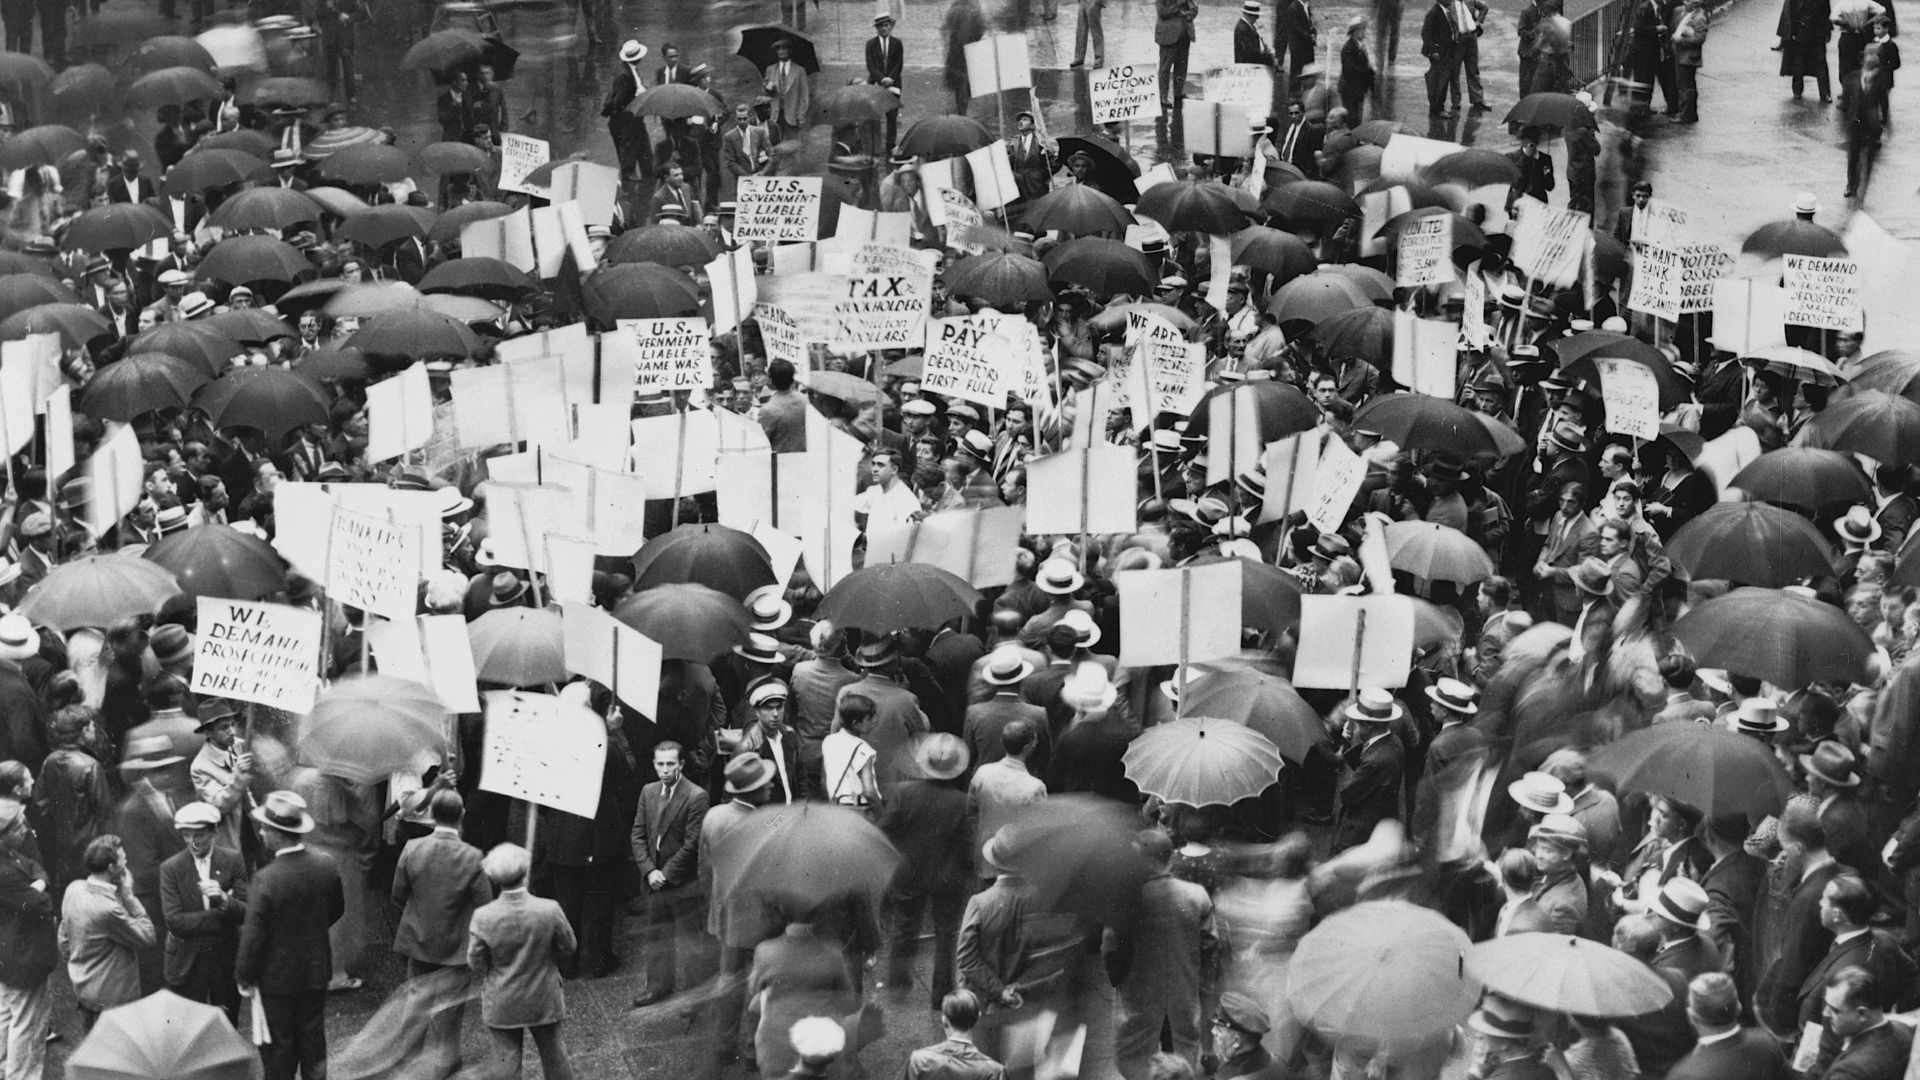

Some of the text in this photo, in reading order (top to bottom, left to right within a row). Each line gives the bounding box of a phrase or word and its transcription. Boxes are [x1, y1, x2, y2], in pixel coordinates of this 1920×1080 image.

[1108, 65, 1133, 80] NO
[1094, 75, 1154, 92] EVICTIONS
[1109, 105, 1140, 119] RENT
[507, 137, 540, 154] UNITED
[740, 193, 818, 204] GOVERNMENT
[755, 204, 806, 216] LIABLE
[752, 216, 780, 226] NAME
[784, 216, 808, 226] WAS
[737, 226, 766, 238] BANK
[1632, 241, 1678, 267] WE WANT
[1641, 260, 1669, 282] BANK
[1787, 257, 1858, 275] WE DEMAND
[1681, 267, 1721, 282] OSSES
[847, 276, 907, 298] TAX
[1798, 303, 1837, 315] SMALL
[1128, 310, 1149, 331] WE
[652, 321, 692, 337] U.S.
[940, 323, 987, 350] PAY
[637, 334, 704, 349] VERNMENT
[641, 347, 688, 360] LIABLE
[938, 343, 989, 365] SMALL
[674, 359, 700, 370] WAS
[635, 374, 660, 386] ANK
[925, 372, 997, 395] FIRST FULL
